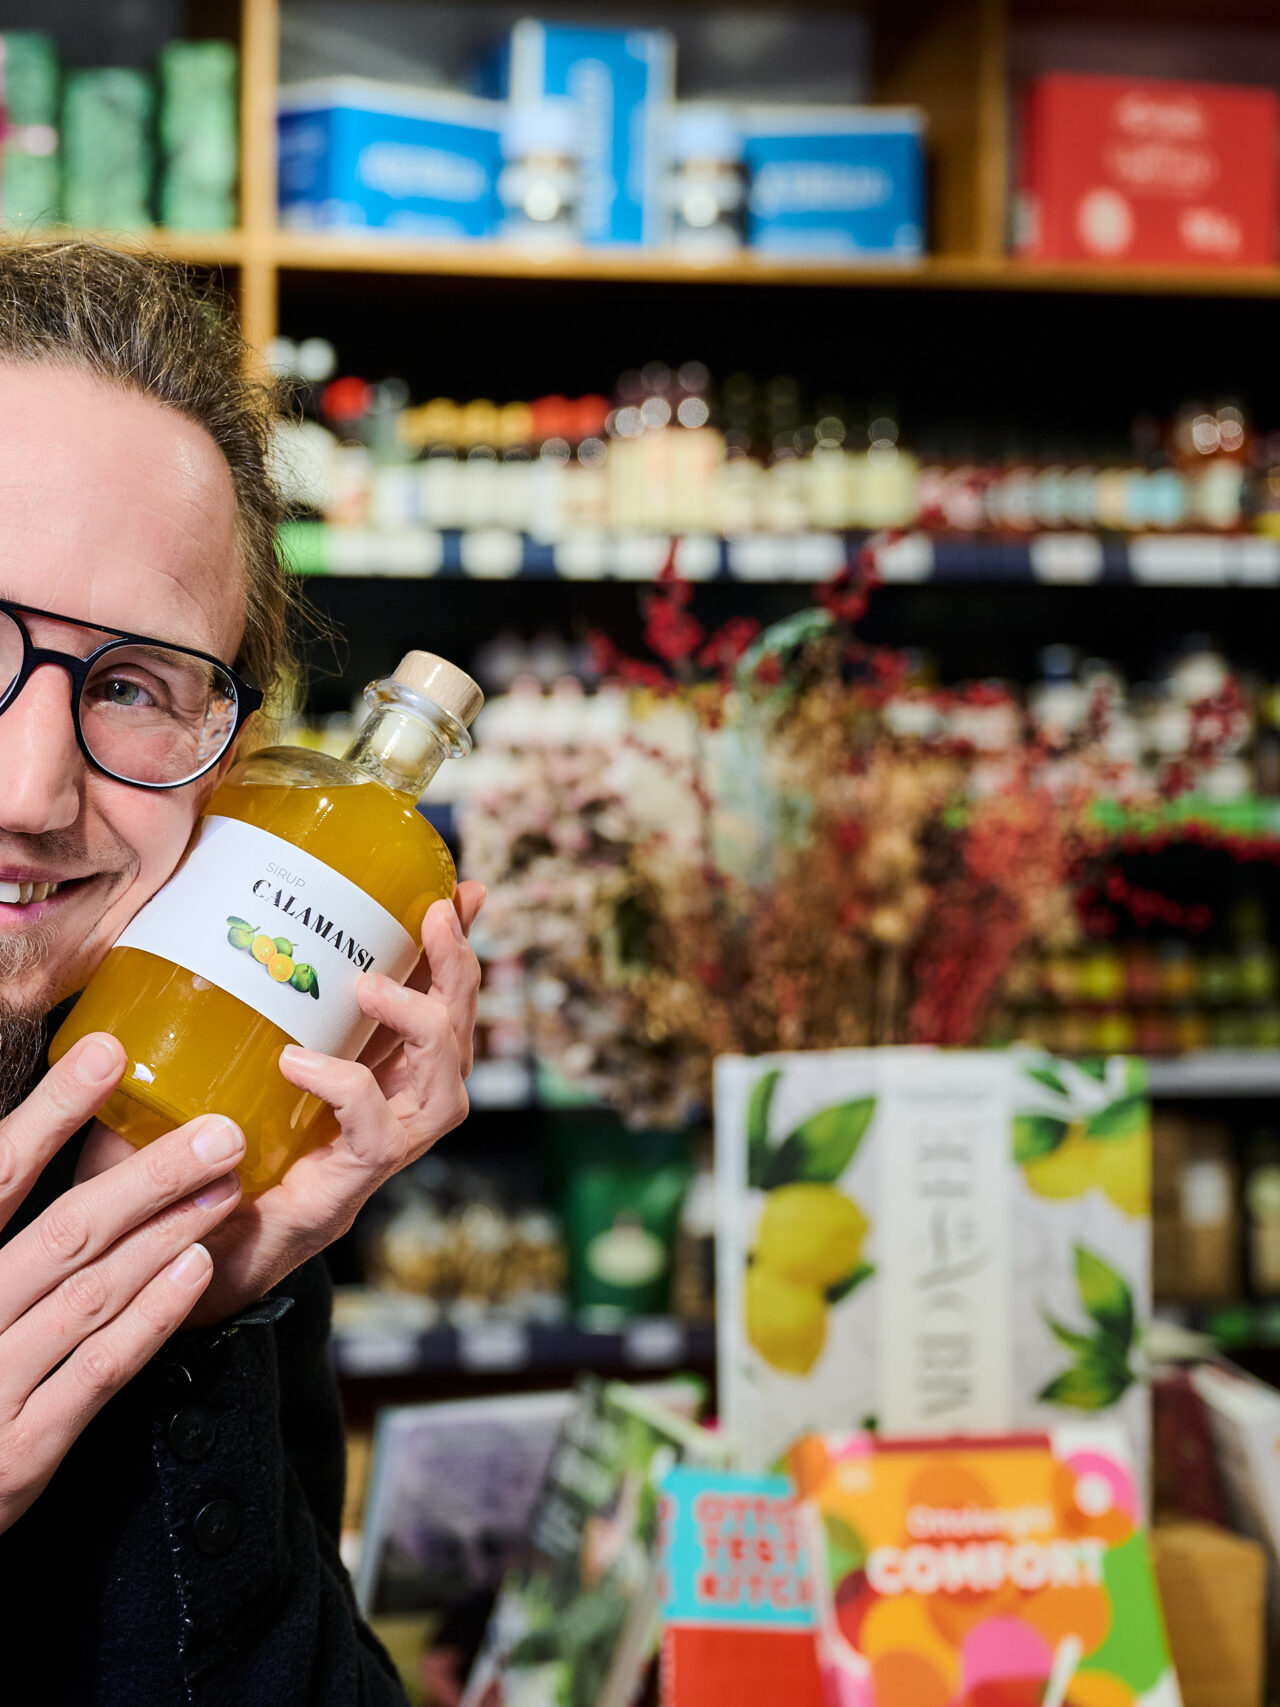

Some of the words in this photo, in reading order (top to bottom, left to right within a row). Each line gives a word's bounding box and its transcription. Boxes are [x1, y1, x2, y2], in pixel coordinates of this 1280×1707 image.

[266, 862, 306, 888] SIRUP
[253, 879, 376, 973] CALAMANSI
[867, 1537, 1106, 1594] COMFORT
